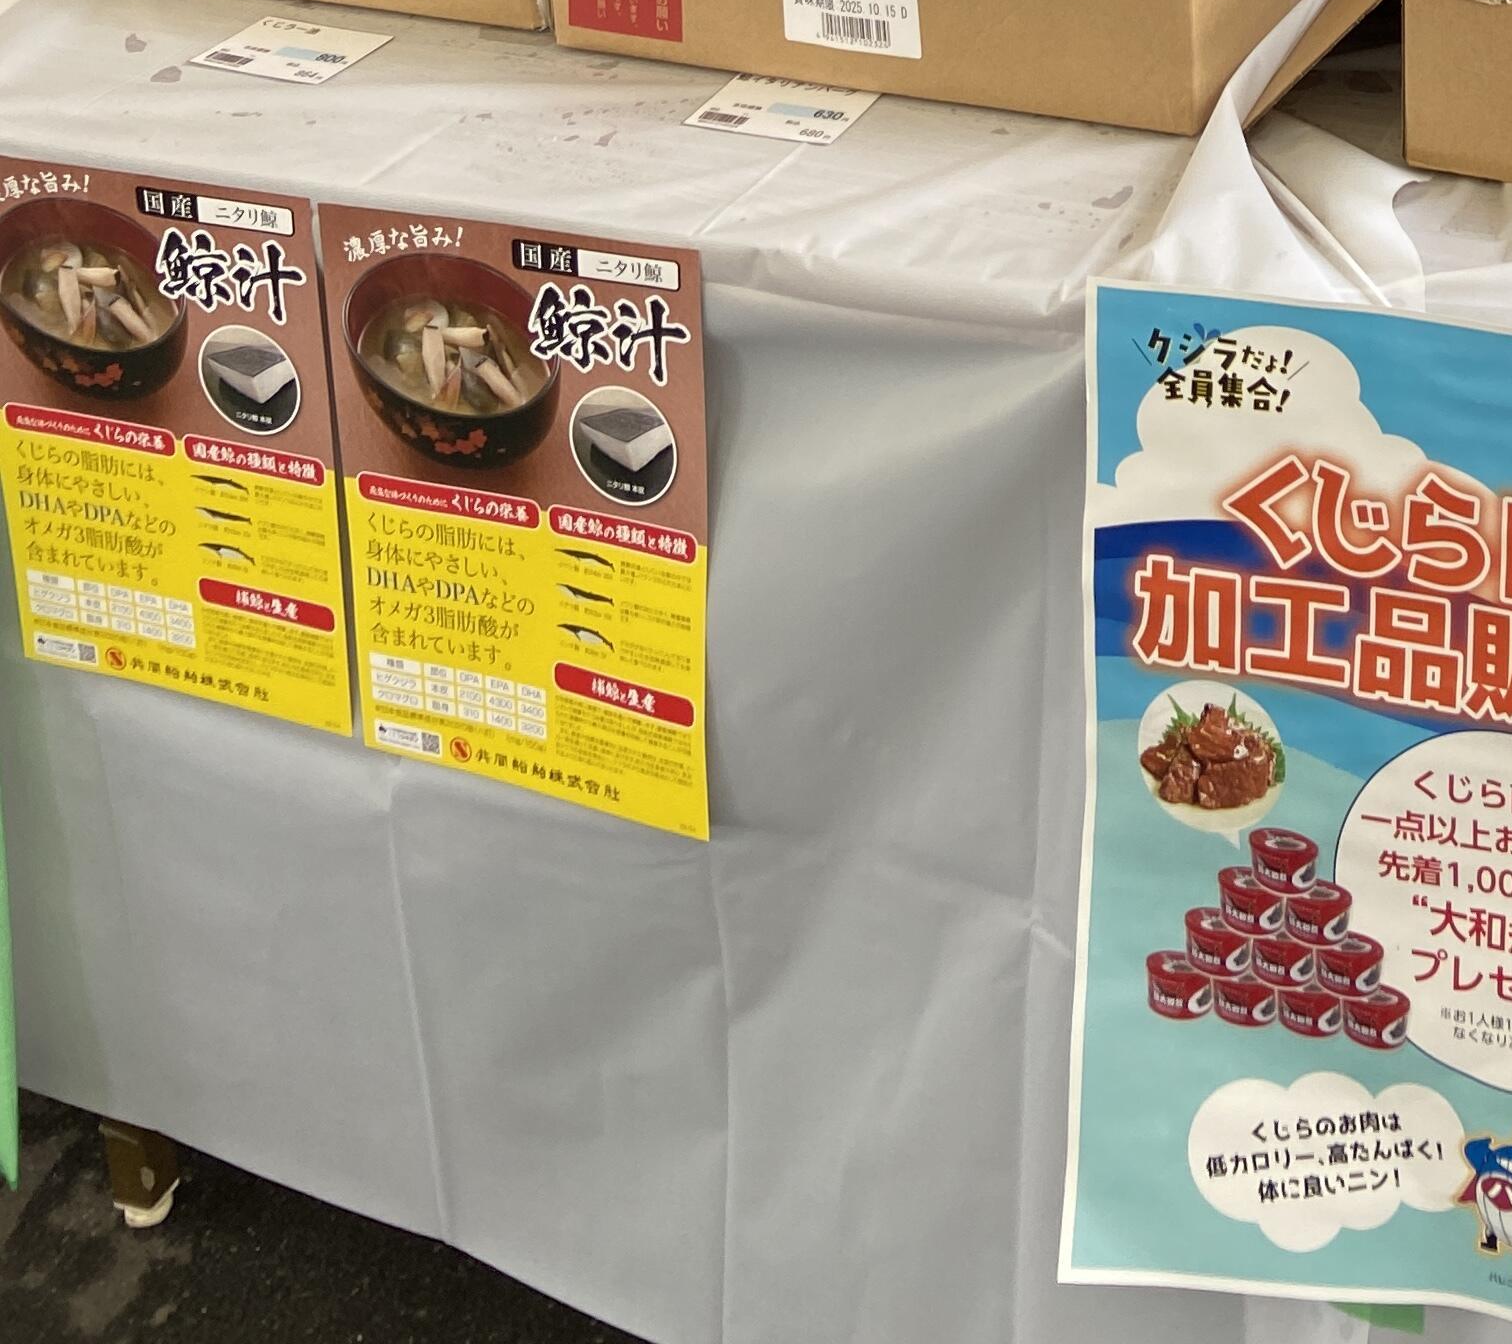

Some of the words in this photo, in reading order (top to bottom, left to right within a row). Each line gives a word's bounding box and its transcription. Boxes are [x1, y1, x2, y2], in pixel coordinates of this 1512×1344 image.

[0, 172, 90, 202] 厚な旨み!
[143, 190, 194, 219] 国産
[215, 205, 279, 229] ニタリ鯨
[343, 226, 464, 263] 濃厚な旨み!
[519, 244, 573, 273] 国産
[596, 256, 663, 283] ニタリ鯨
[157, 229, 305, 324] 鯨汁
[527, 282, 692, 387] 鯨汁
[1157, 367, 1291, 413] 全員集合!
[16, 438, 164, 486] くじらの脂肪には、
[17, 463, 150, 509] 身体にやさしい、
[20, 491, 176, 536] DHAやDPAなどの
[367, 512, 525, 561] くじらの脂肪には、
[24, 517, 163, 558] オメガ3脂肪酸が
[26, 541, 160, 587] 含まれています。
[366, 538, 508, 586] 身体にやさしい、
[367, 566, 535, 616] DHAやDPAなどの
[369, 594, 519, 640] オメガ3脂肪酸が
[371, 623, 512, 671] 含まれています。
[1252, 1110, 1402, 1142] くじらのお肉は
[1258, 1167, 1400, 1204] 体に良いニン!
